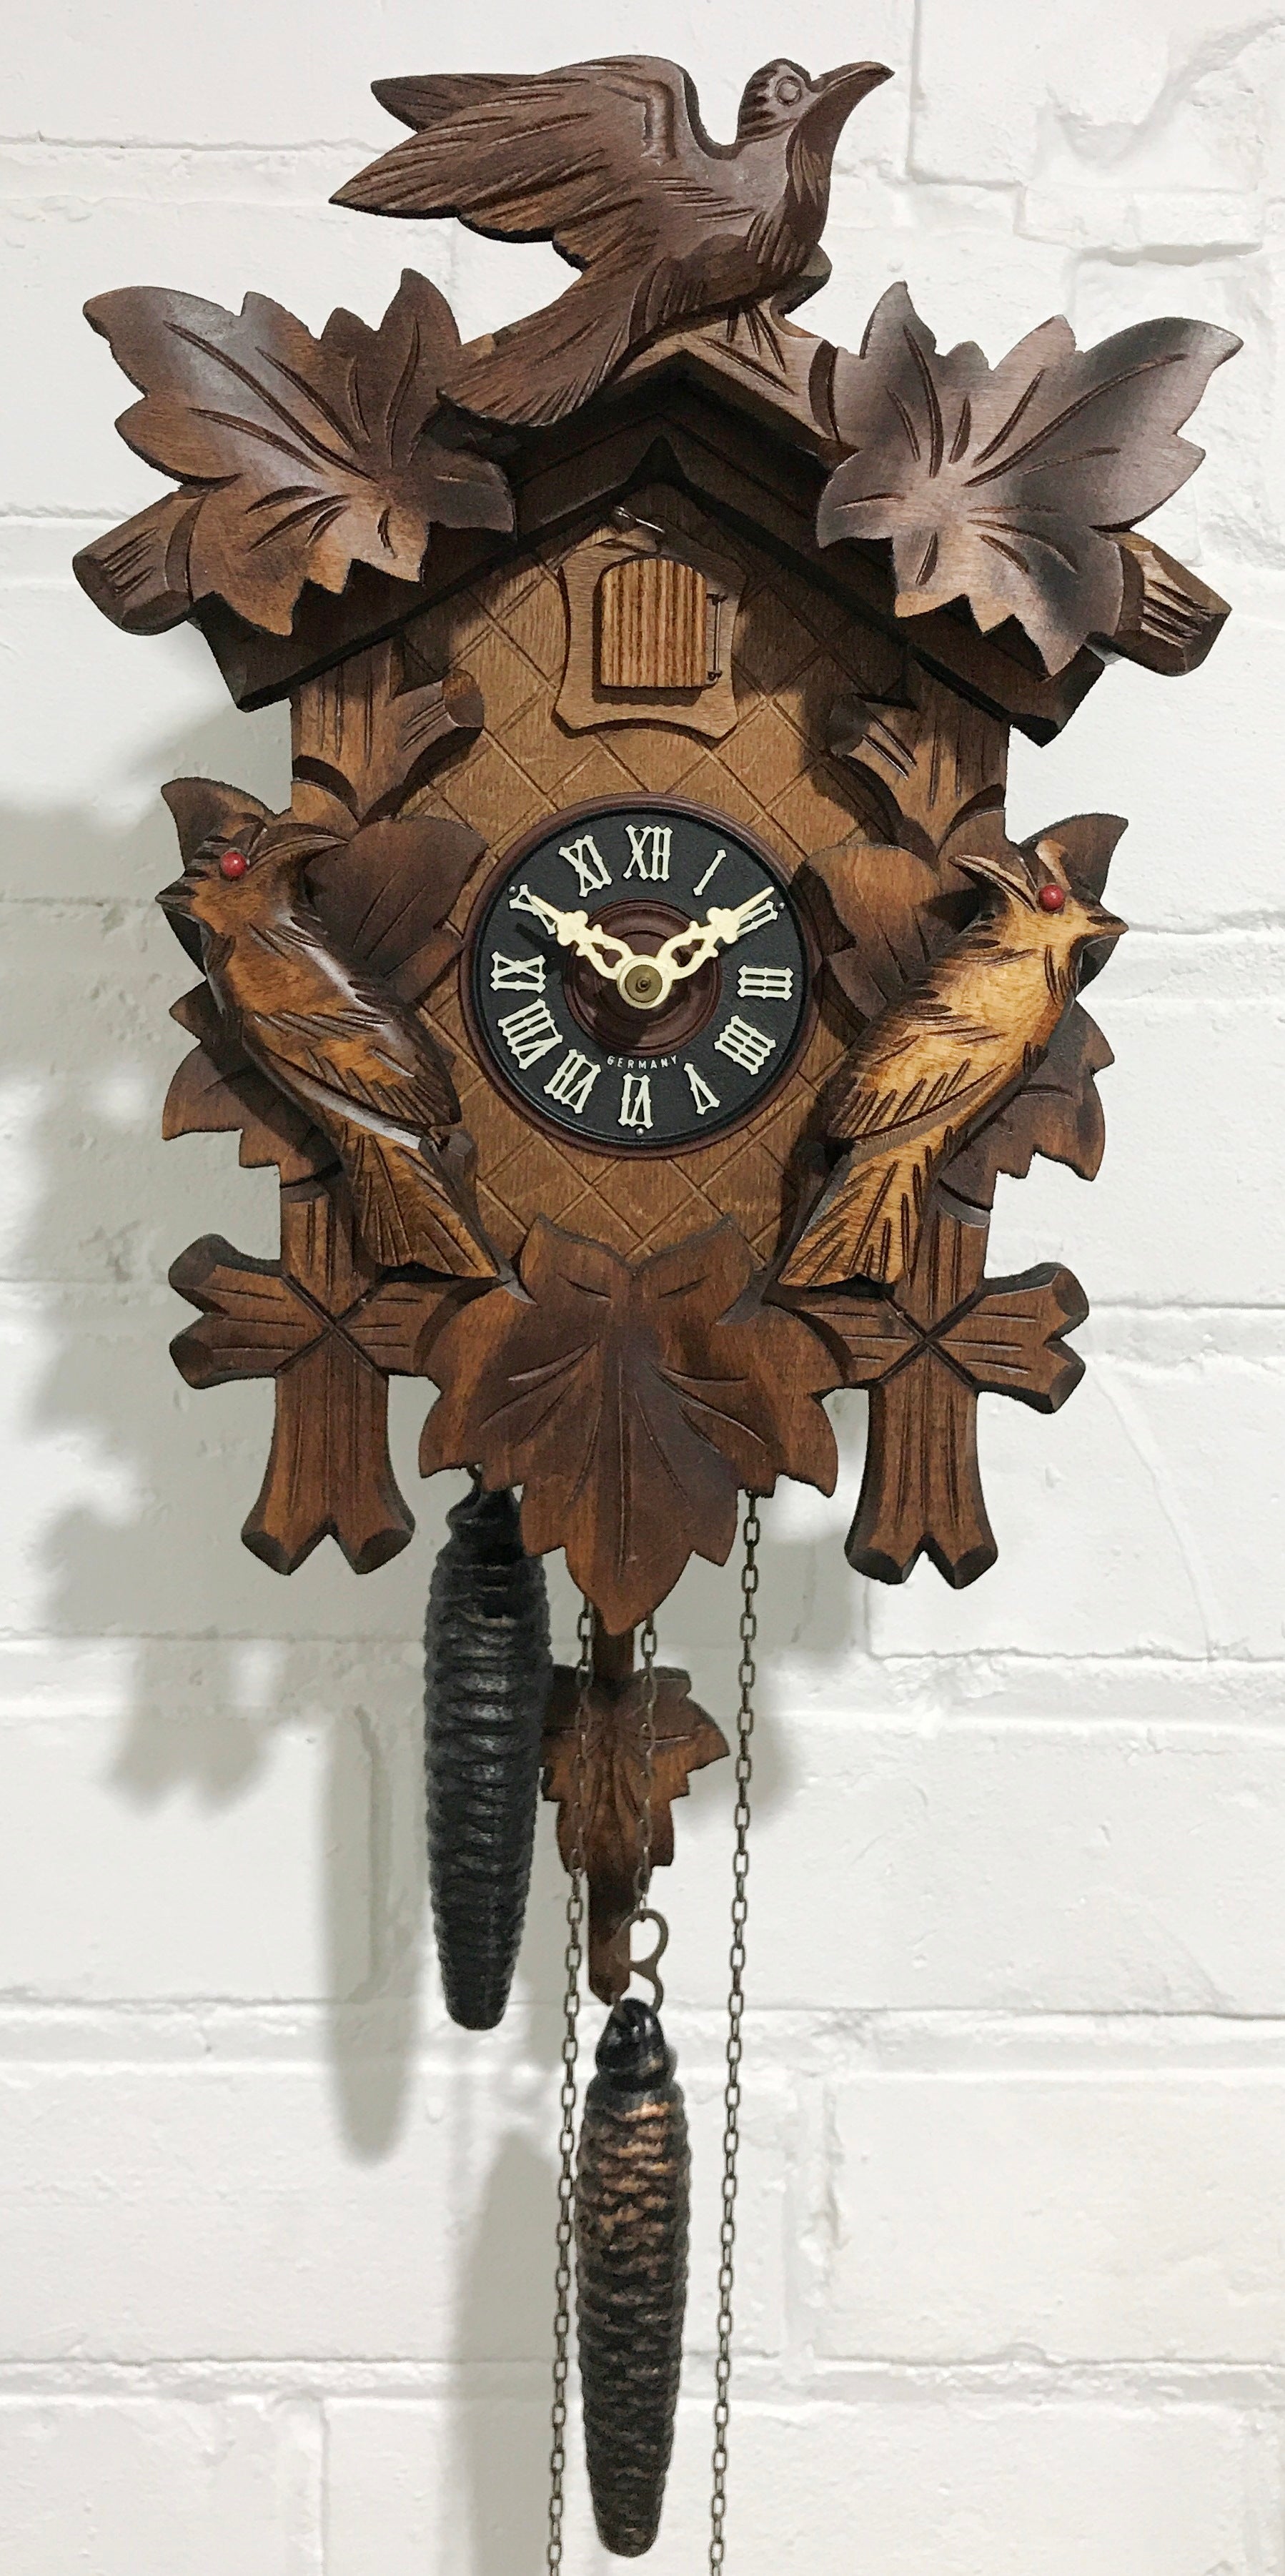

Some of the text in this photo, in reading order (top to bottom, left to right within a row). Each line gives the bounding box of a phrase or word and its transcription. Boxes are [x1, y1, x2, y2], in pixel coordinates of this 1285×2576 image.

[558, 835, 612, 897] XI
[623, 825, 673, 881] XII
[693, 850, 726, 896] I
[490, 951, 546, 993] IX
[738, 965, 794, 1000] III
[497, 999, 562, 1069] VIII
[607, 1055, 677, 1069] GERMANY
[715, 1015, 776, 1075] IIII
[544, 1049, 601, 1114] VII
[617, 1073, 653, 1129] VI
[684, 1063, 720, 1115] V
